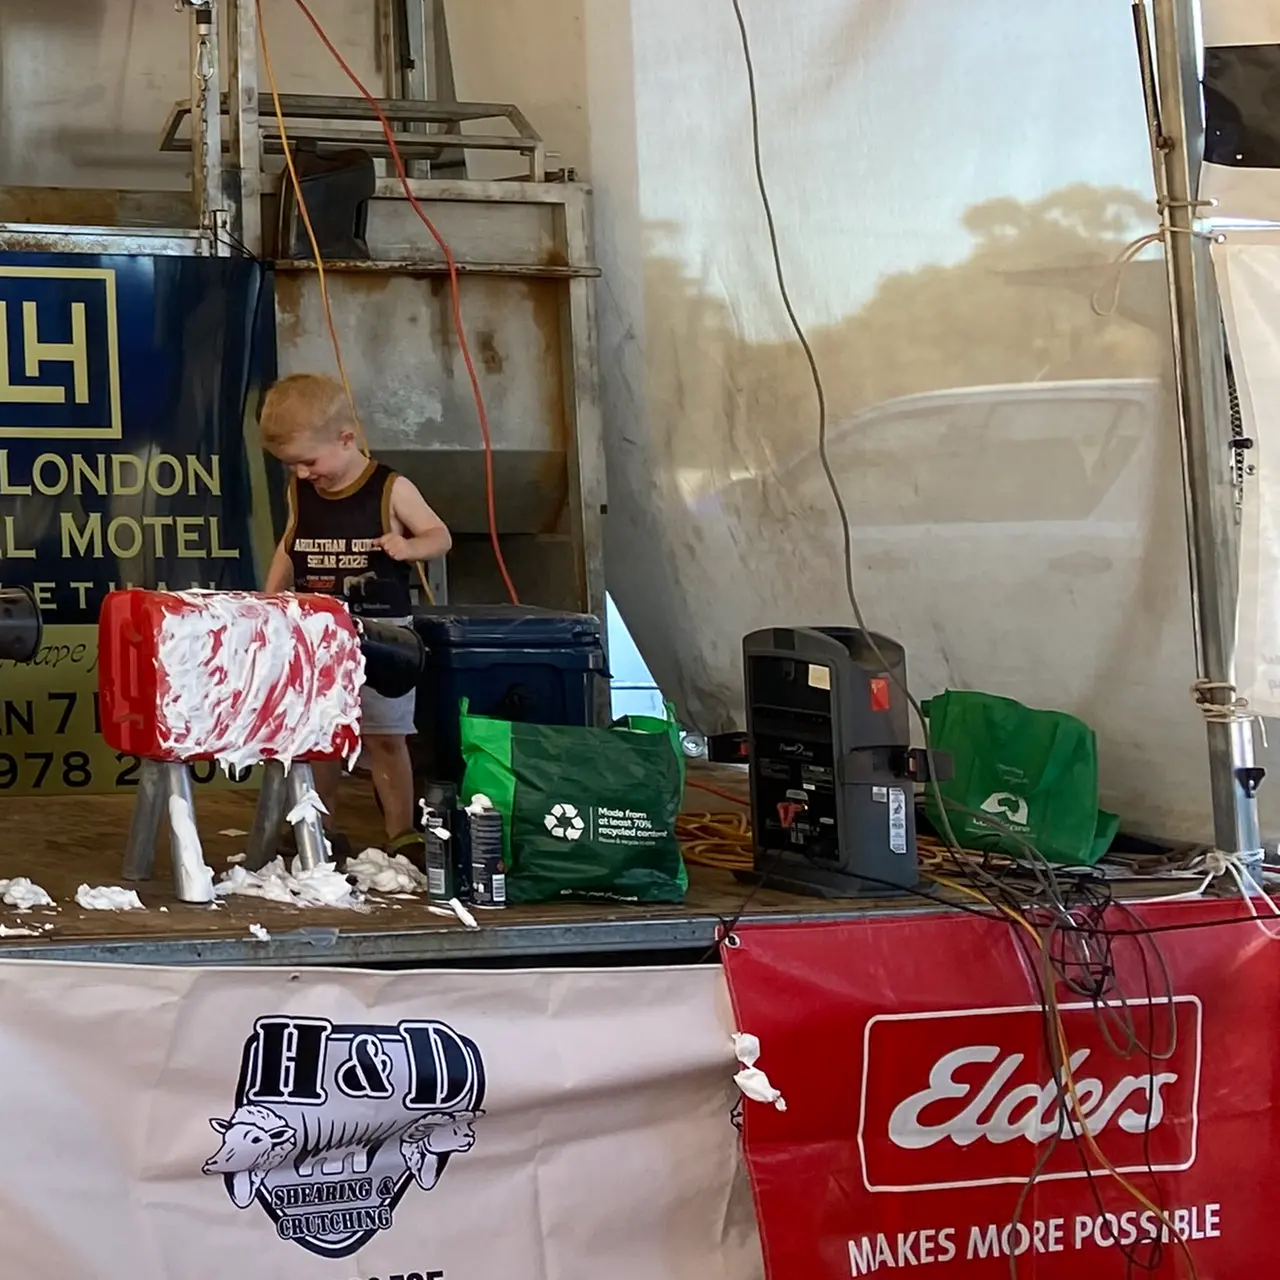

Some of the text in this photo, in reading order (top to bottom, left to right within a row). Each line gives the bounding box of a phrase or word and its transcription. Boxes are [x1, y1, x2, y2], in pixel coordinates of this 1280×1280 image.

[60, 512, 239, 559] MOTEL
[48, 691, 77, 734] 7
[598, 807, 647, 819] Made from
[609, 818, 632, 827] least
[633, 820, 652, 829] 70%
[598, 827, 636, 837] recycled
[888, 1045, 1178, 1150] Elders
[272, 1177, 395, 1209] SHEARING &
[277, 1206, 393, 1239] CRUTCHING
[848, 1203, 1222, 1277] MAKES MORE POSSIBLE
